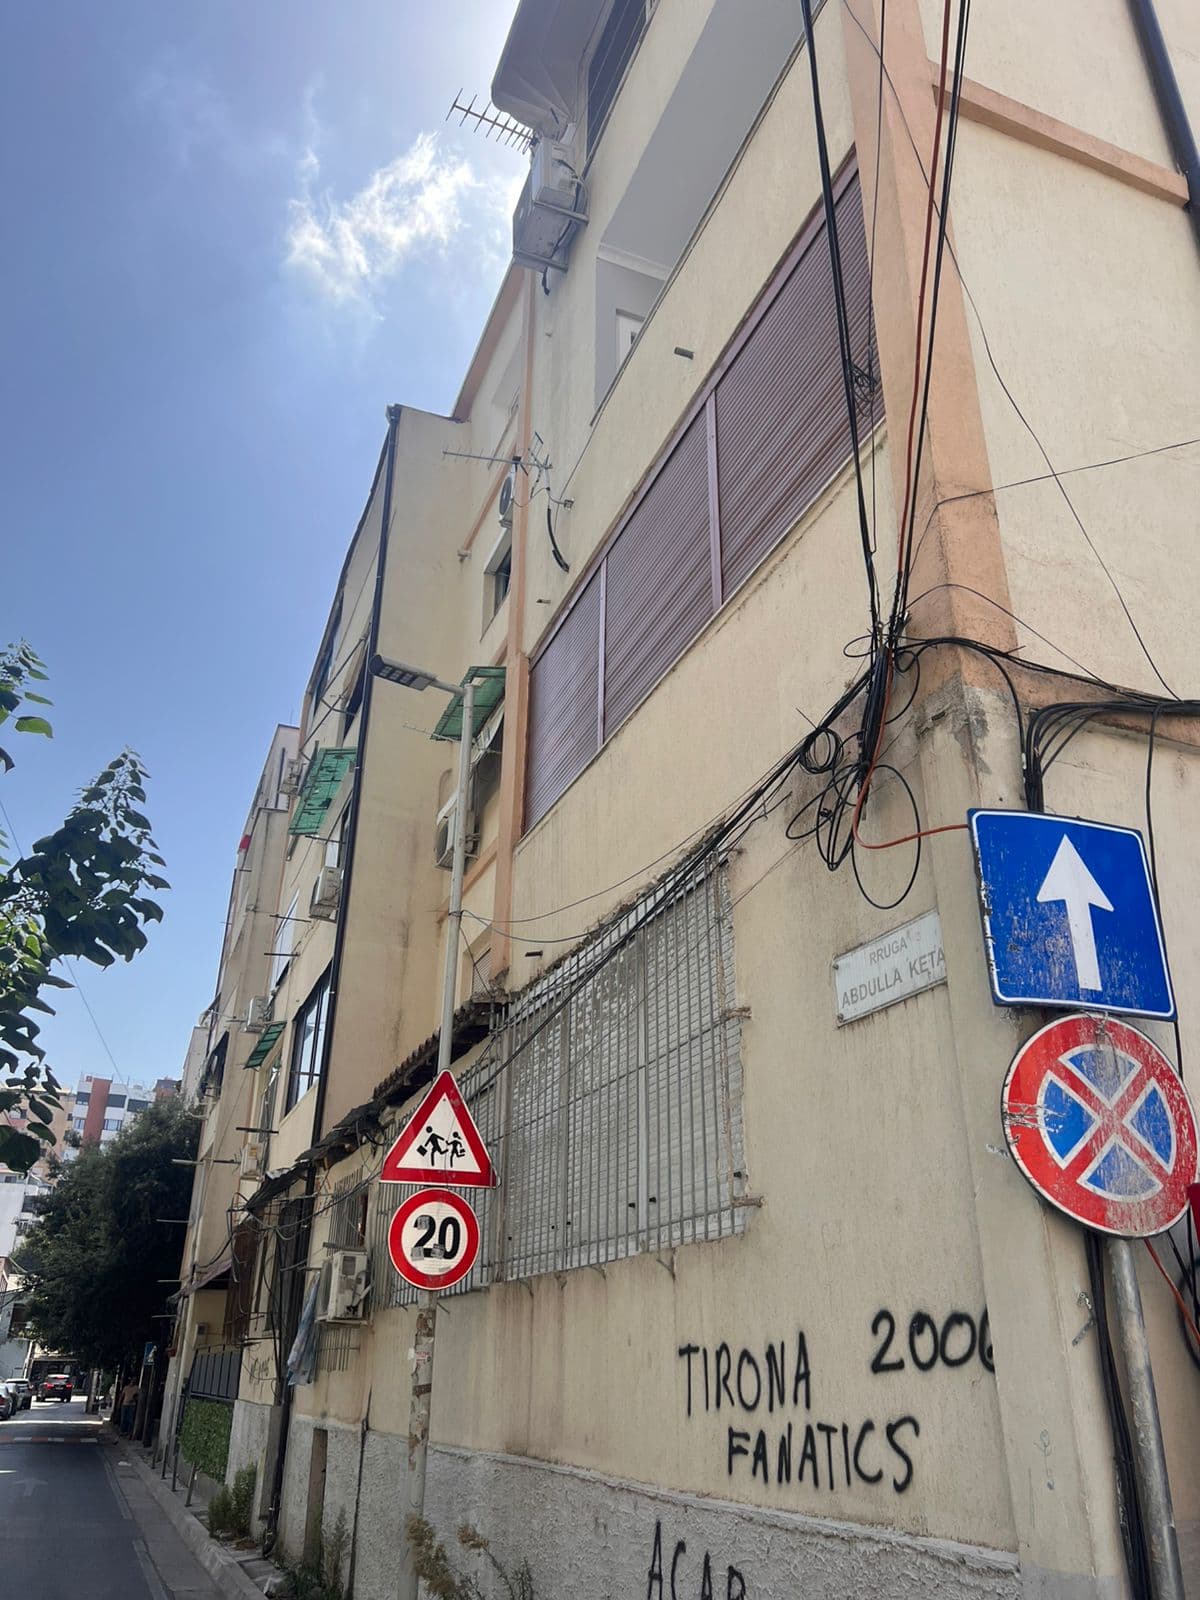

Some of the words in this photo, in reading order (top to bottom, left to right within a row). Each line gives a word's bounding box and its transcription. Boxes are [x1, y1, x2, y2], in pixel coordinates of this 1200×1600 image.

[841, 968, 903, 1009] ABDULLA
[908, 947, 946, 979] KETA
[869, 936, 908, 965] RRUGA
[410, 1214, 461, 1260] 20
[677, 1330, 812, 1418] TIRONA
[727, 1415, 921, 1494] FANATICS
